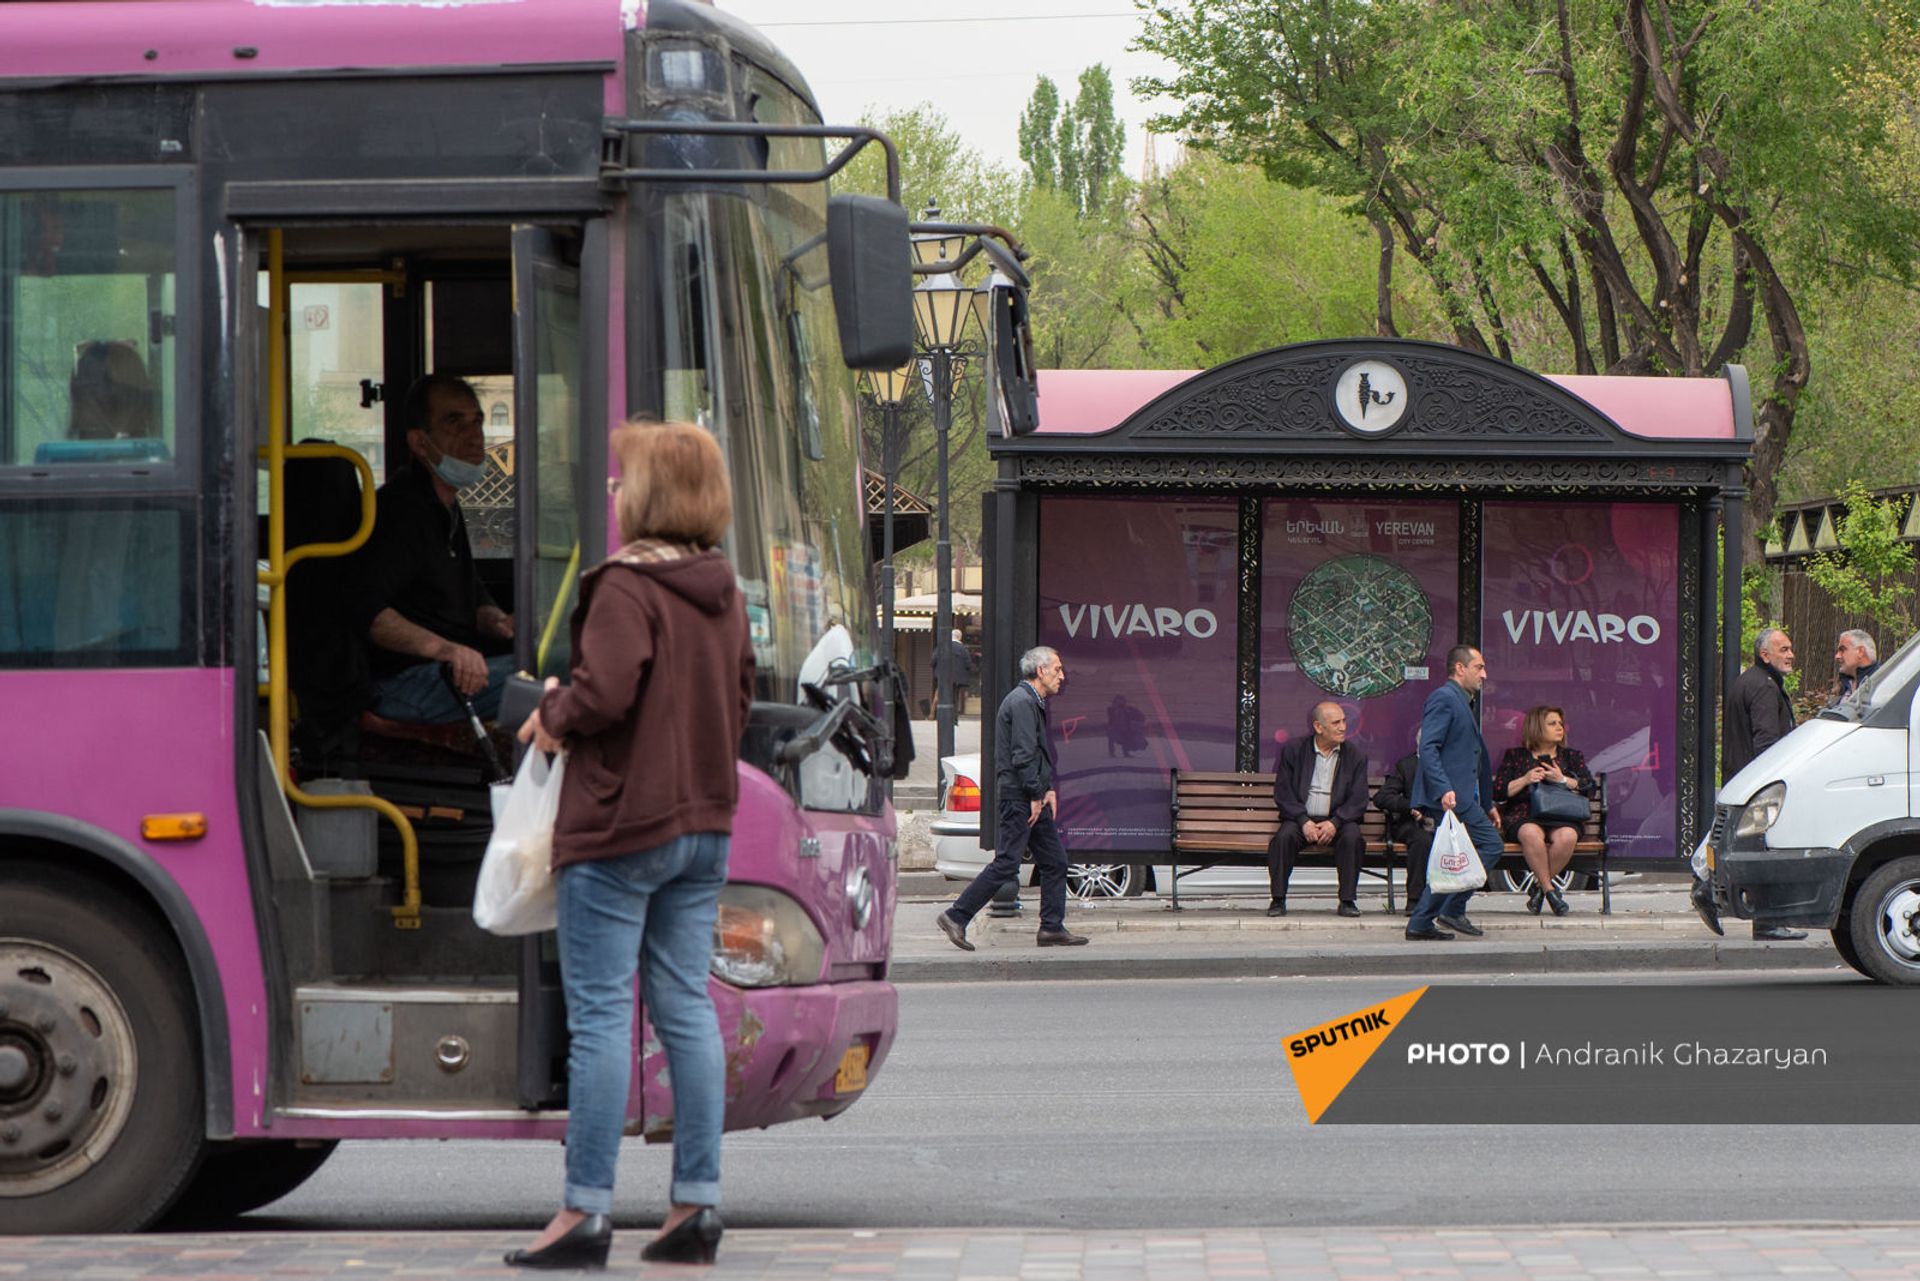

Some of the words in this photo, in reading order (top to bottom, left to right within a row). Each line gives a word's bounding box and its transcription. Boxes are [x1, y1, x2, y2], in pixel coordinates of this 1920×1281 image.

[1286, 520, 1344, 534] ԵՐԵՎԱՆ
[1376, 521, 1434, 536] YEREVAN
[1059, 603, 1218, 639] VIVARO
[1502, 609, 1661, 645] VIVARO
